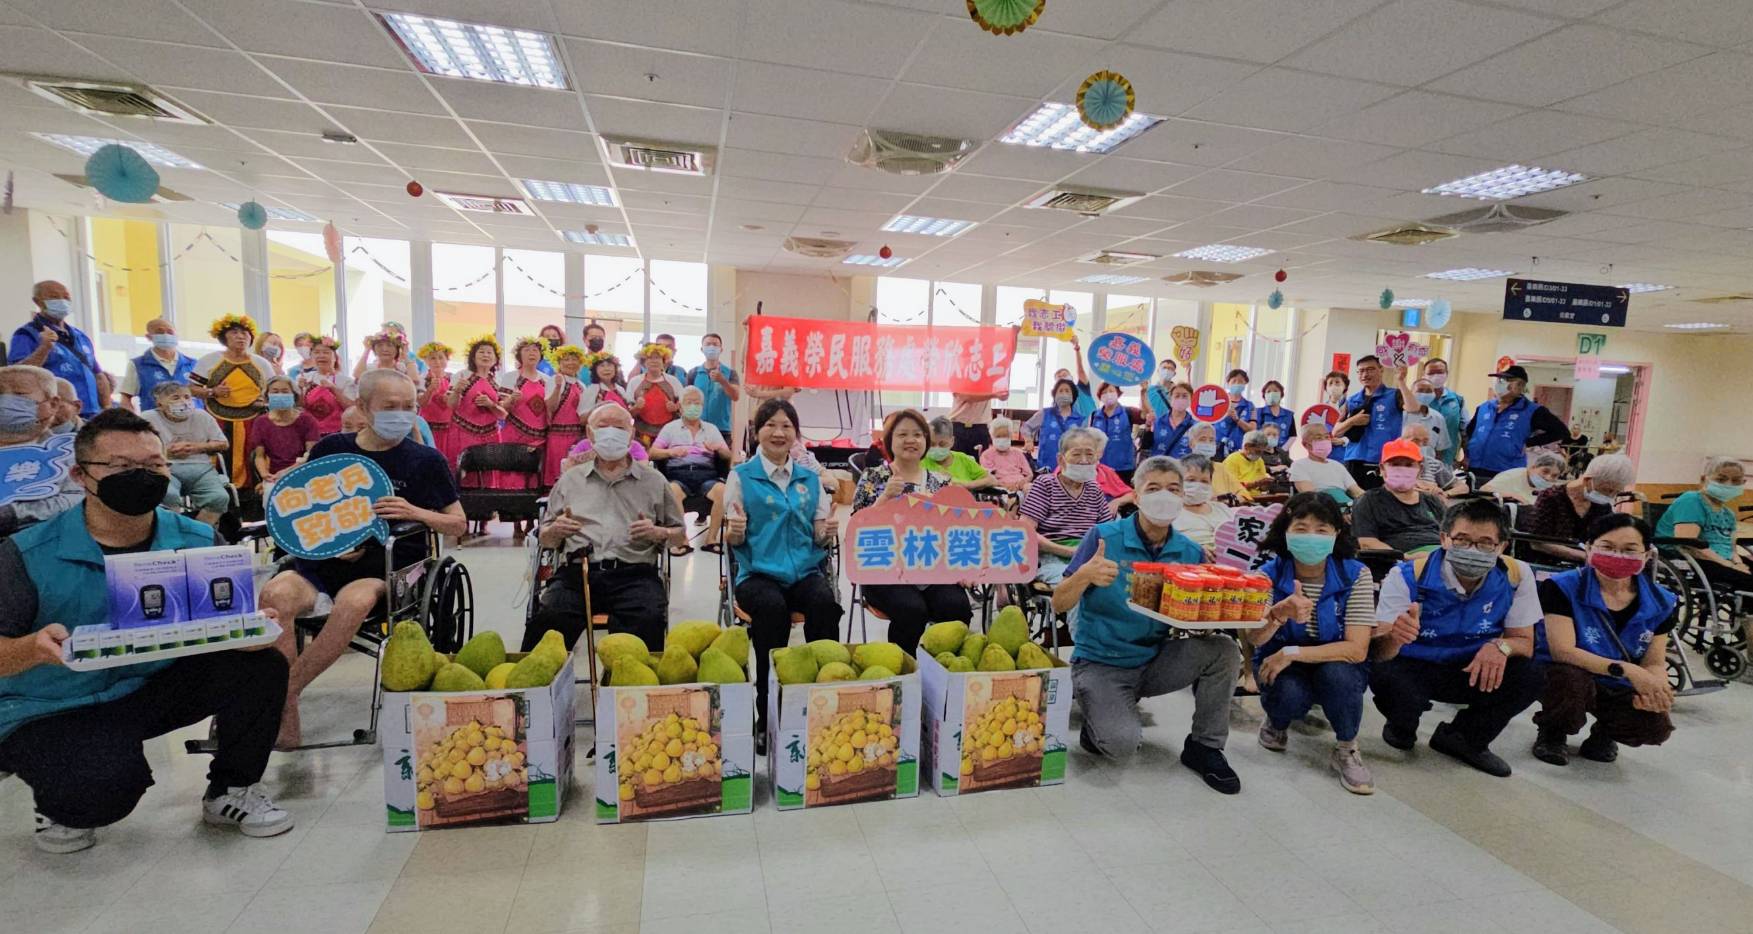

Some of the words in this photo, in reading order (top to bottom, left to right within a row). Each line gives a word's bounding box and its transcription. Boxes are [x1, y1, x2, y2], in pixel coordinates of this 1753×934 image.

[275, 465, 371, 514] 向老兵
[294, 497, 374, 548] 致敬
[855, 527, 1026, 568] 雲林榮家
